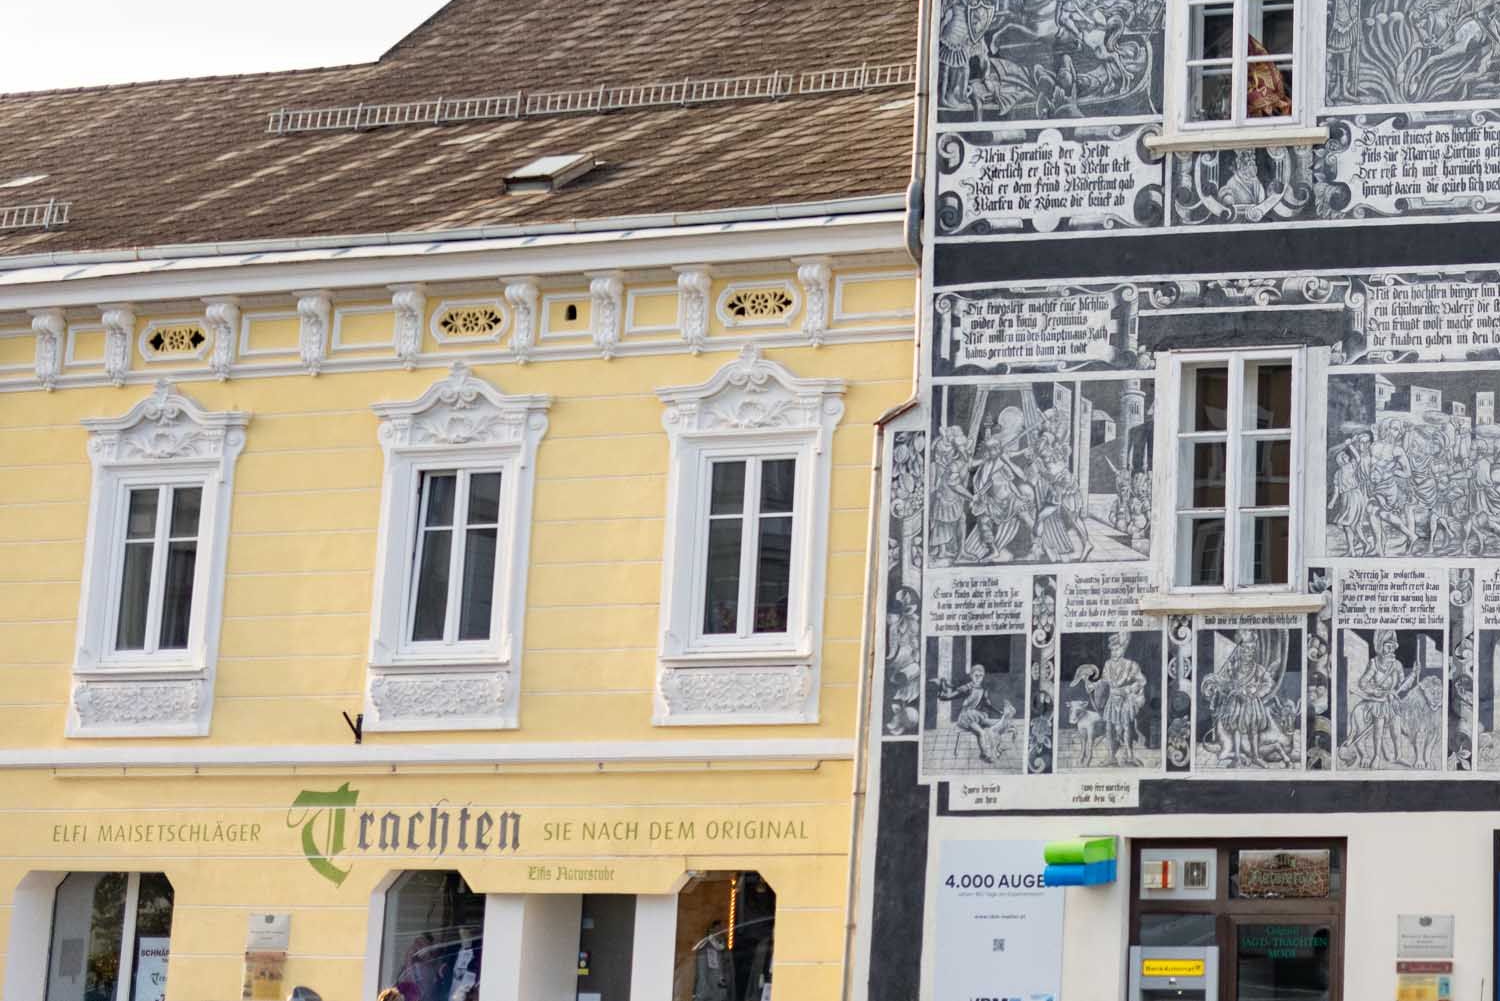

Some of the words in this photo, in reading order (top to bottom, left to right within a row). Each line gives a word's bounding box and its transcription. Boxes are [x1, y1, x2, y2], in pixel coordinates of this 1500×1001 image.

[53, 824, 88, 842] ELFI
[97, 821, 261, 842] MAISETSCHLÄGER
[287, 782, 521, 888] Trachten
[543, 822, 573, 840] SIE
[582, 822, 639, 840] NACH
[649, 821, 695, 840] DEM
[705, 820, 808, 840] ORIGINAL
[944, 874, 995, 888] 4.000
